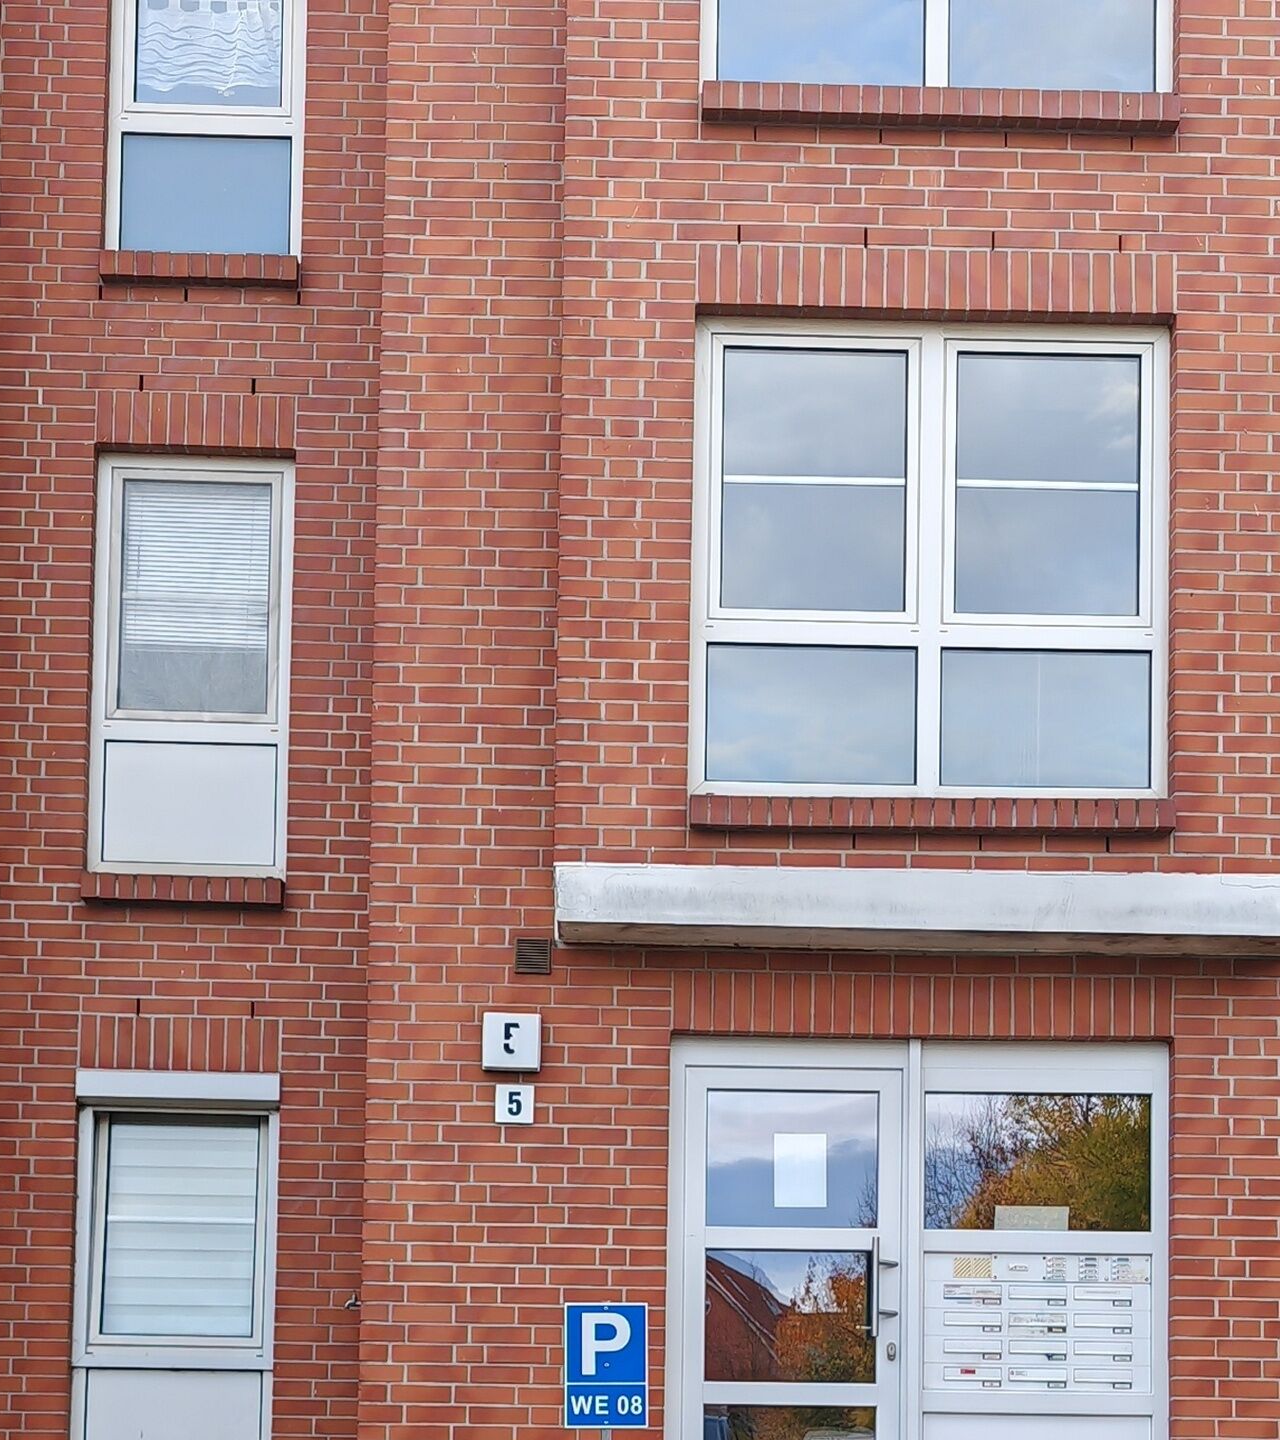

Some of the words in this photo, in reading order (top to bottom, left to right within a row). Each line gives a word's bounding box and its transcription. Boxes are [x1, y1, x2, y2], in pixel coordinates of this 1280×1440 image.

[507, 1091, 523, 1116] 5
[581, 1312, 631, 1376] P
[570, 1395, 609, 1415] WE
[617, 1395, 643, 1415] 08
